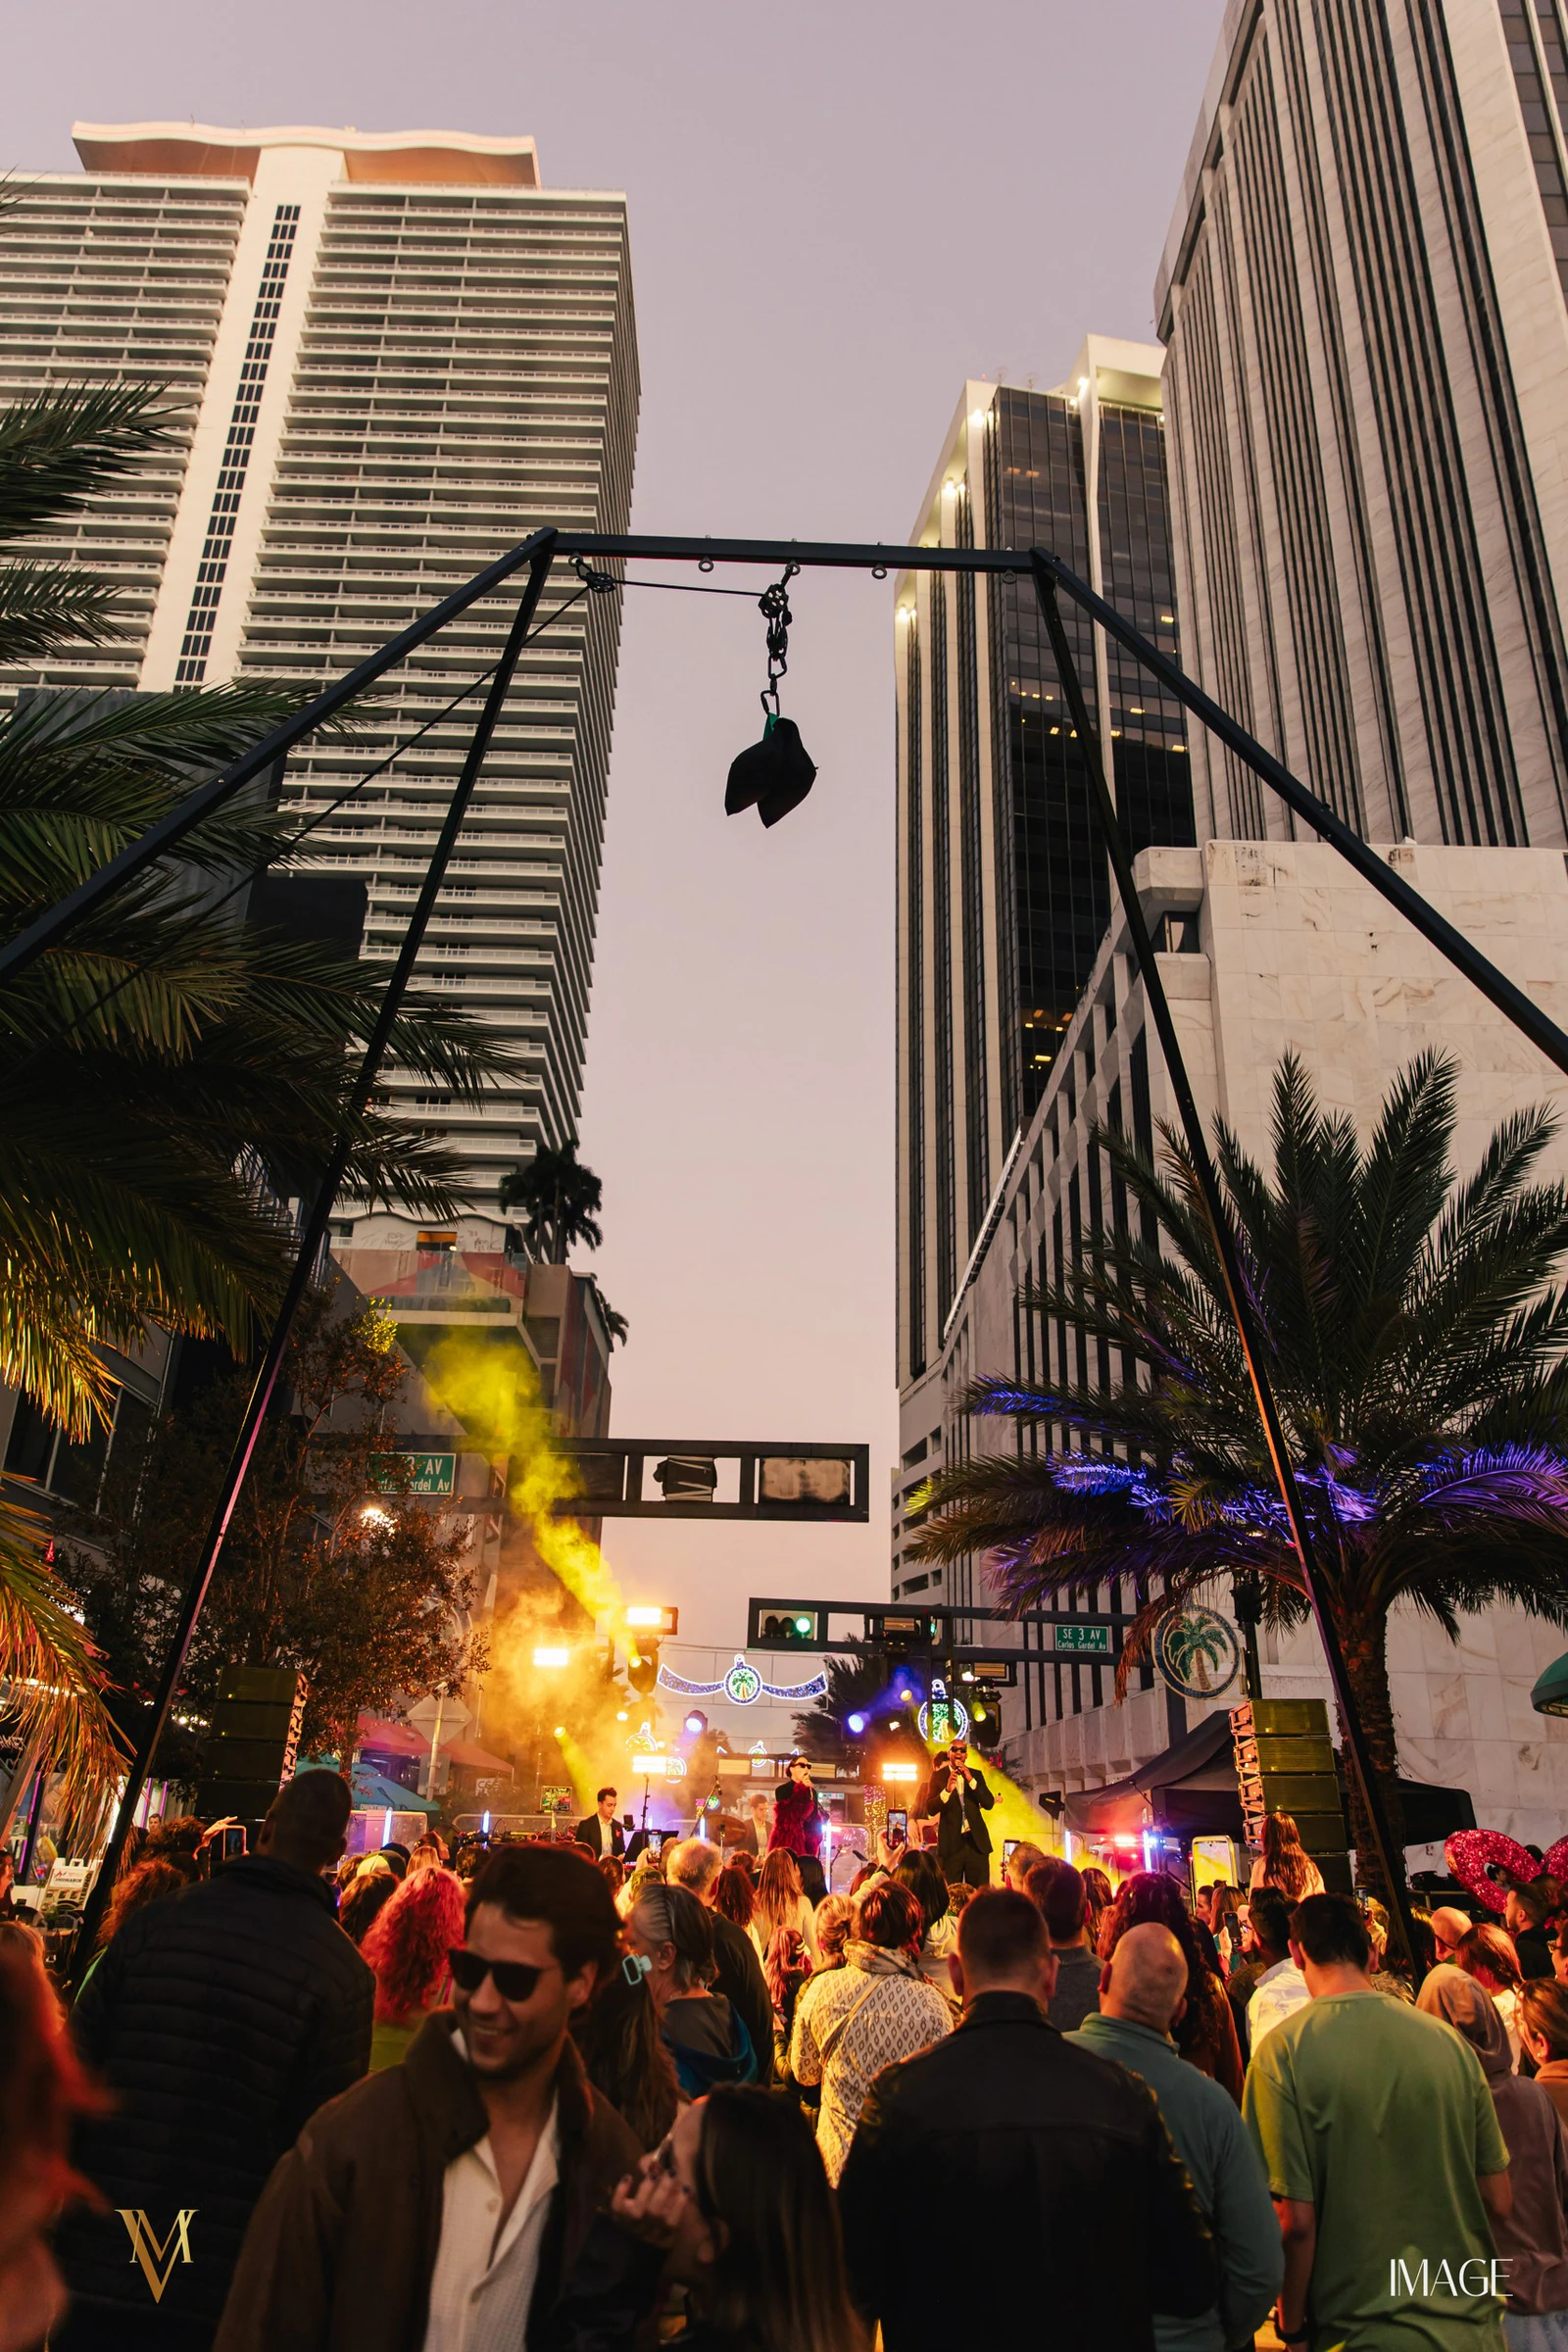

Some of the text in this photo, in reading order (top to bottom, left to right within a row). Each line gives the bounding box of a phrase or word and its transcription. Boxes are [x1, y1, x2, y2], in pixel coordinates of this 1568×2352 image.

[424, 1458, 443, 1475] AV
[437, 1478, 450, 1492] Av
[1062, 1628, 1101, 1641] SE 3 AV
[1058, 1641, 1075, 1649] Carlos
[1099, 1642, 1106, 1650] Av
[78, 1872, 93, 1906] ATERING
